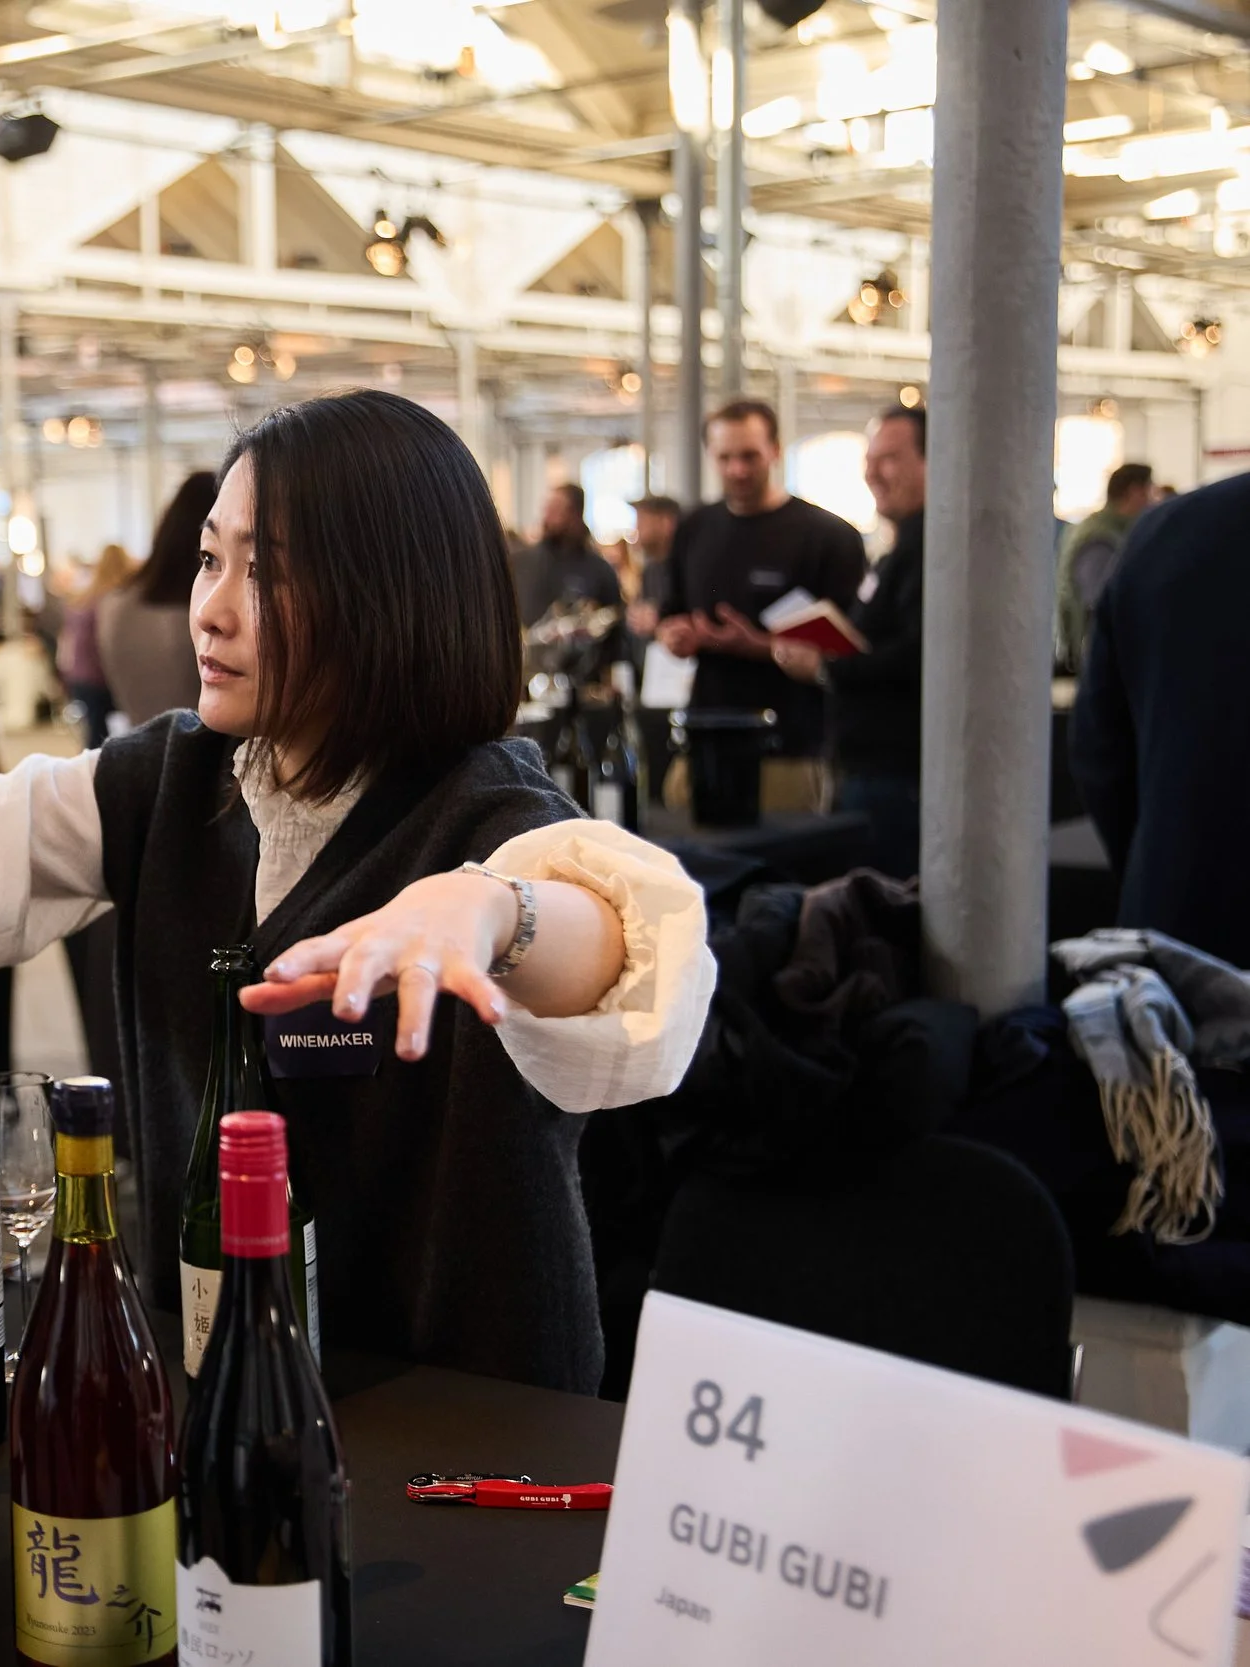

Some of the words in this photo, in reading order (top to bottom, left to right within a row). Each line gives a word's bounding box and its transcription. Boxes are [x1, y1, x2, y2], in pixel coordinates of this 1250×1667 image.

[279, 1033, 373, 1048] WINEMAKER
[192, 1278, 211, 1351] 小姫さ
[685, 1379, 766, 1463] 84
[26, 1519, 162, 1655] 龍之介
[669, 1502, 769, 1574] GUBI
[778, 1543, 888, 1620] GUBI
[26, 1612, 69, 1636] Ryunosuke
[71, 1624, 97, 1636] 2023
[654, 1586, 713, 1625] Japan
